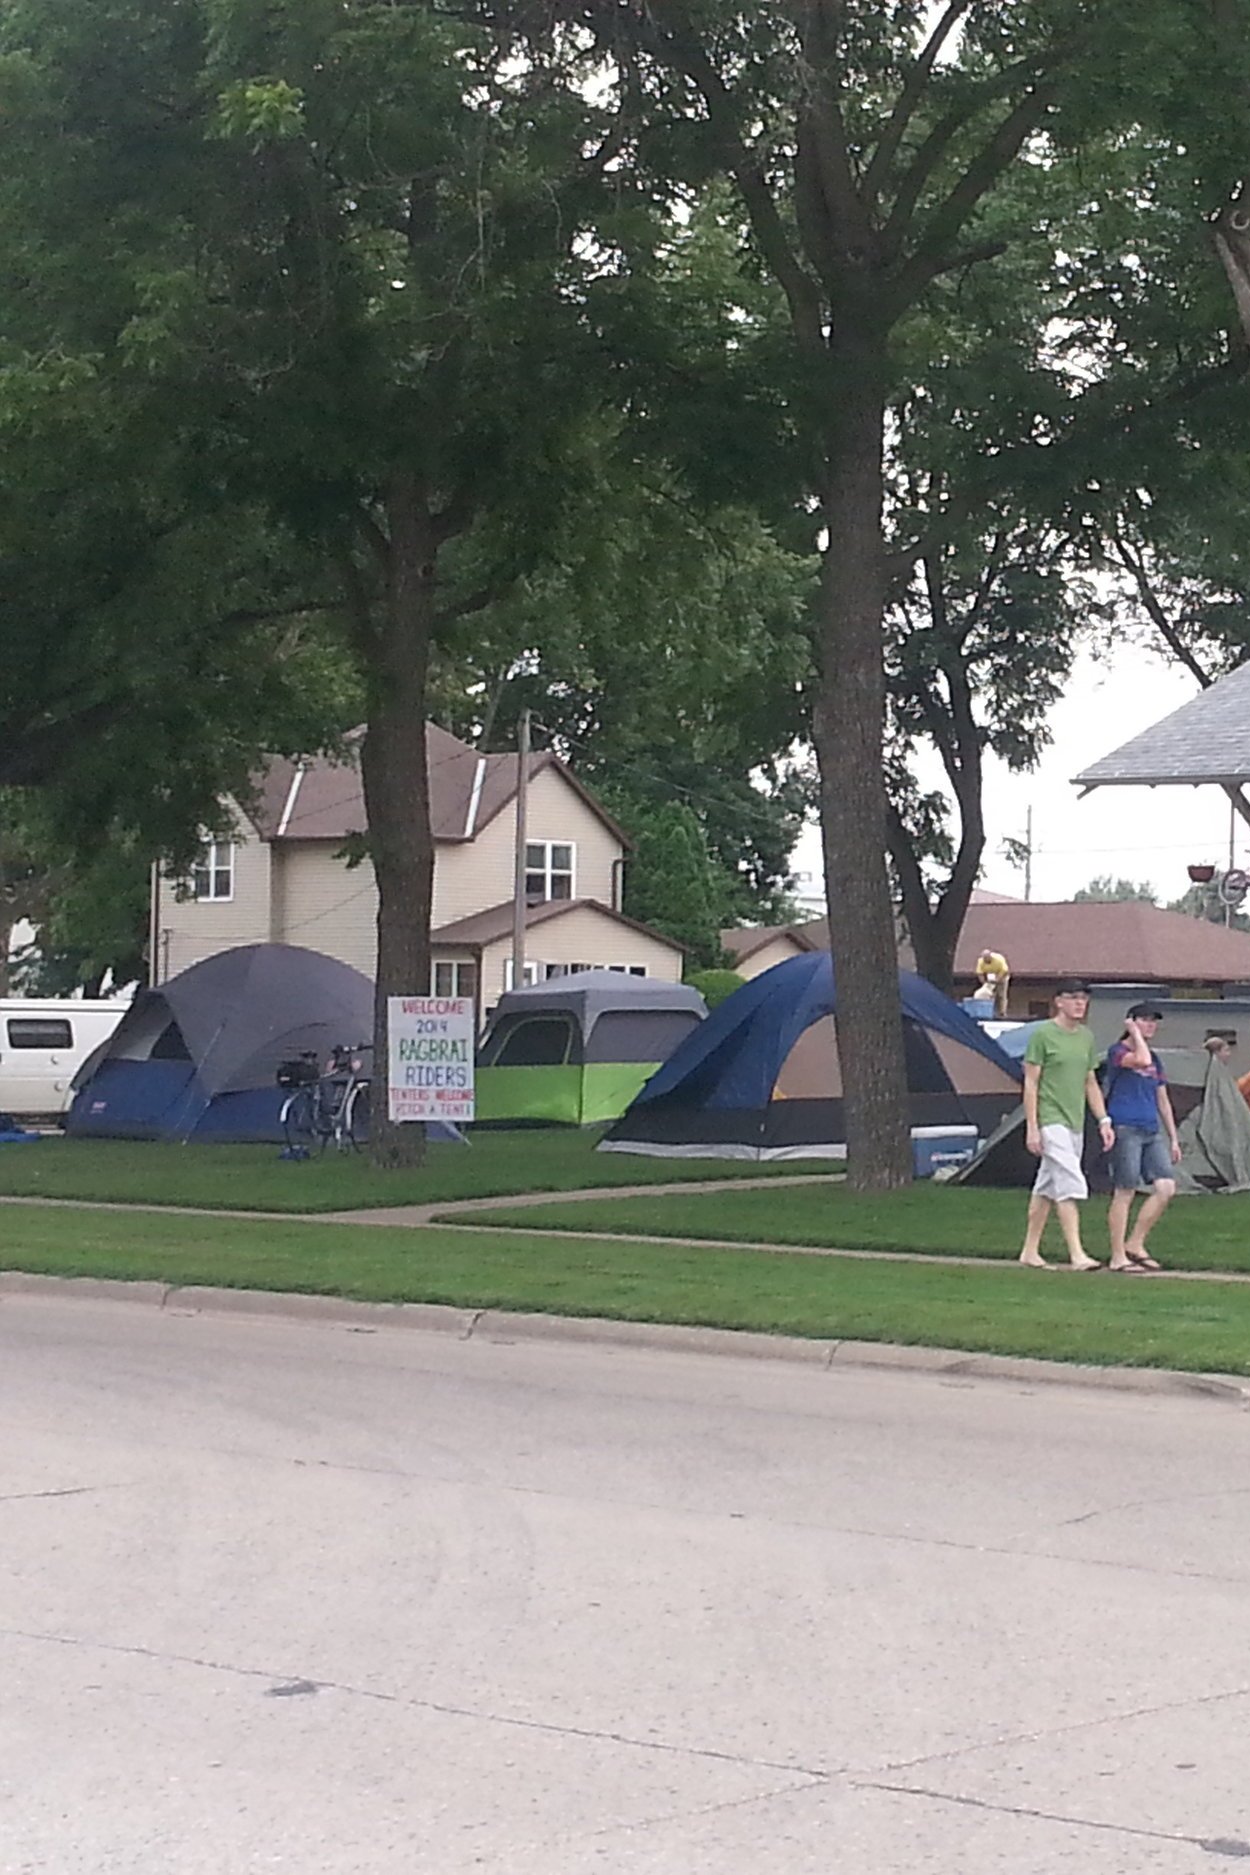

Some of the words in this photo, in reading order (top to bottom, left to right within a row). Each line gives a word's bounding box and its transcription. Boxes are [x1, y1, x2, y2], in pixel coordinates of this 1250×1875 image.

[401, 999, 465, 1015] WELCOME
[416, 1019, 449, 1033] 2014
[399, 1038, 468, 1061] RAGBRAI
[405, 1066, 467, 1087] RIDERS
